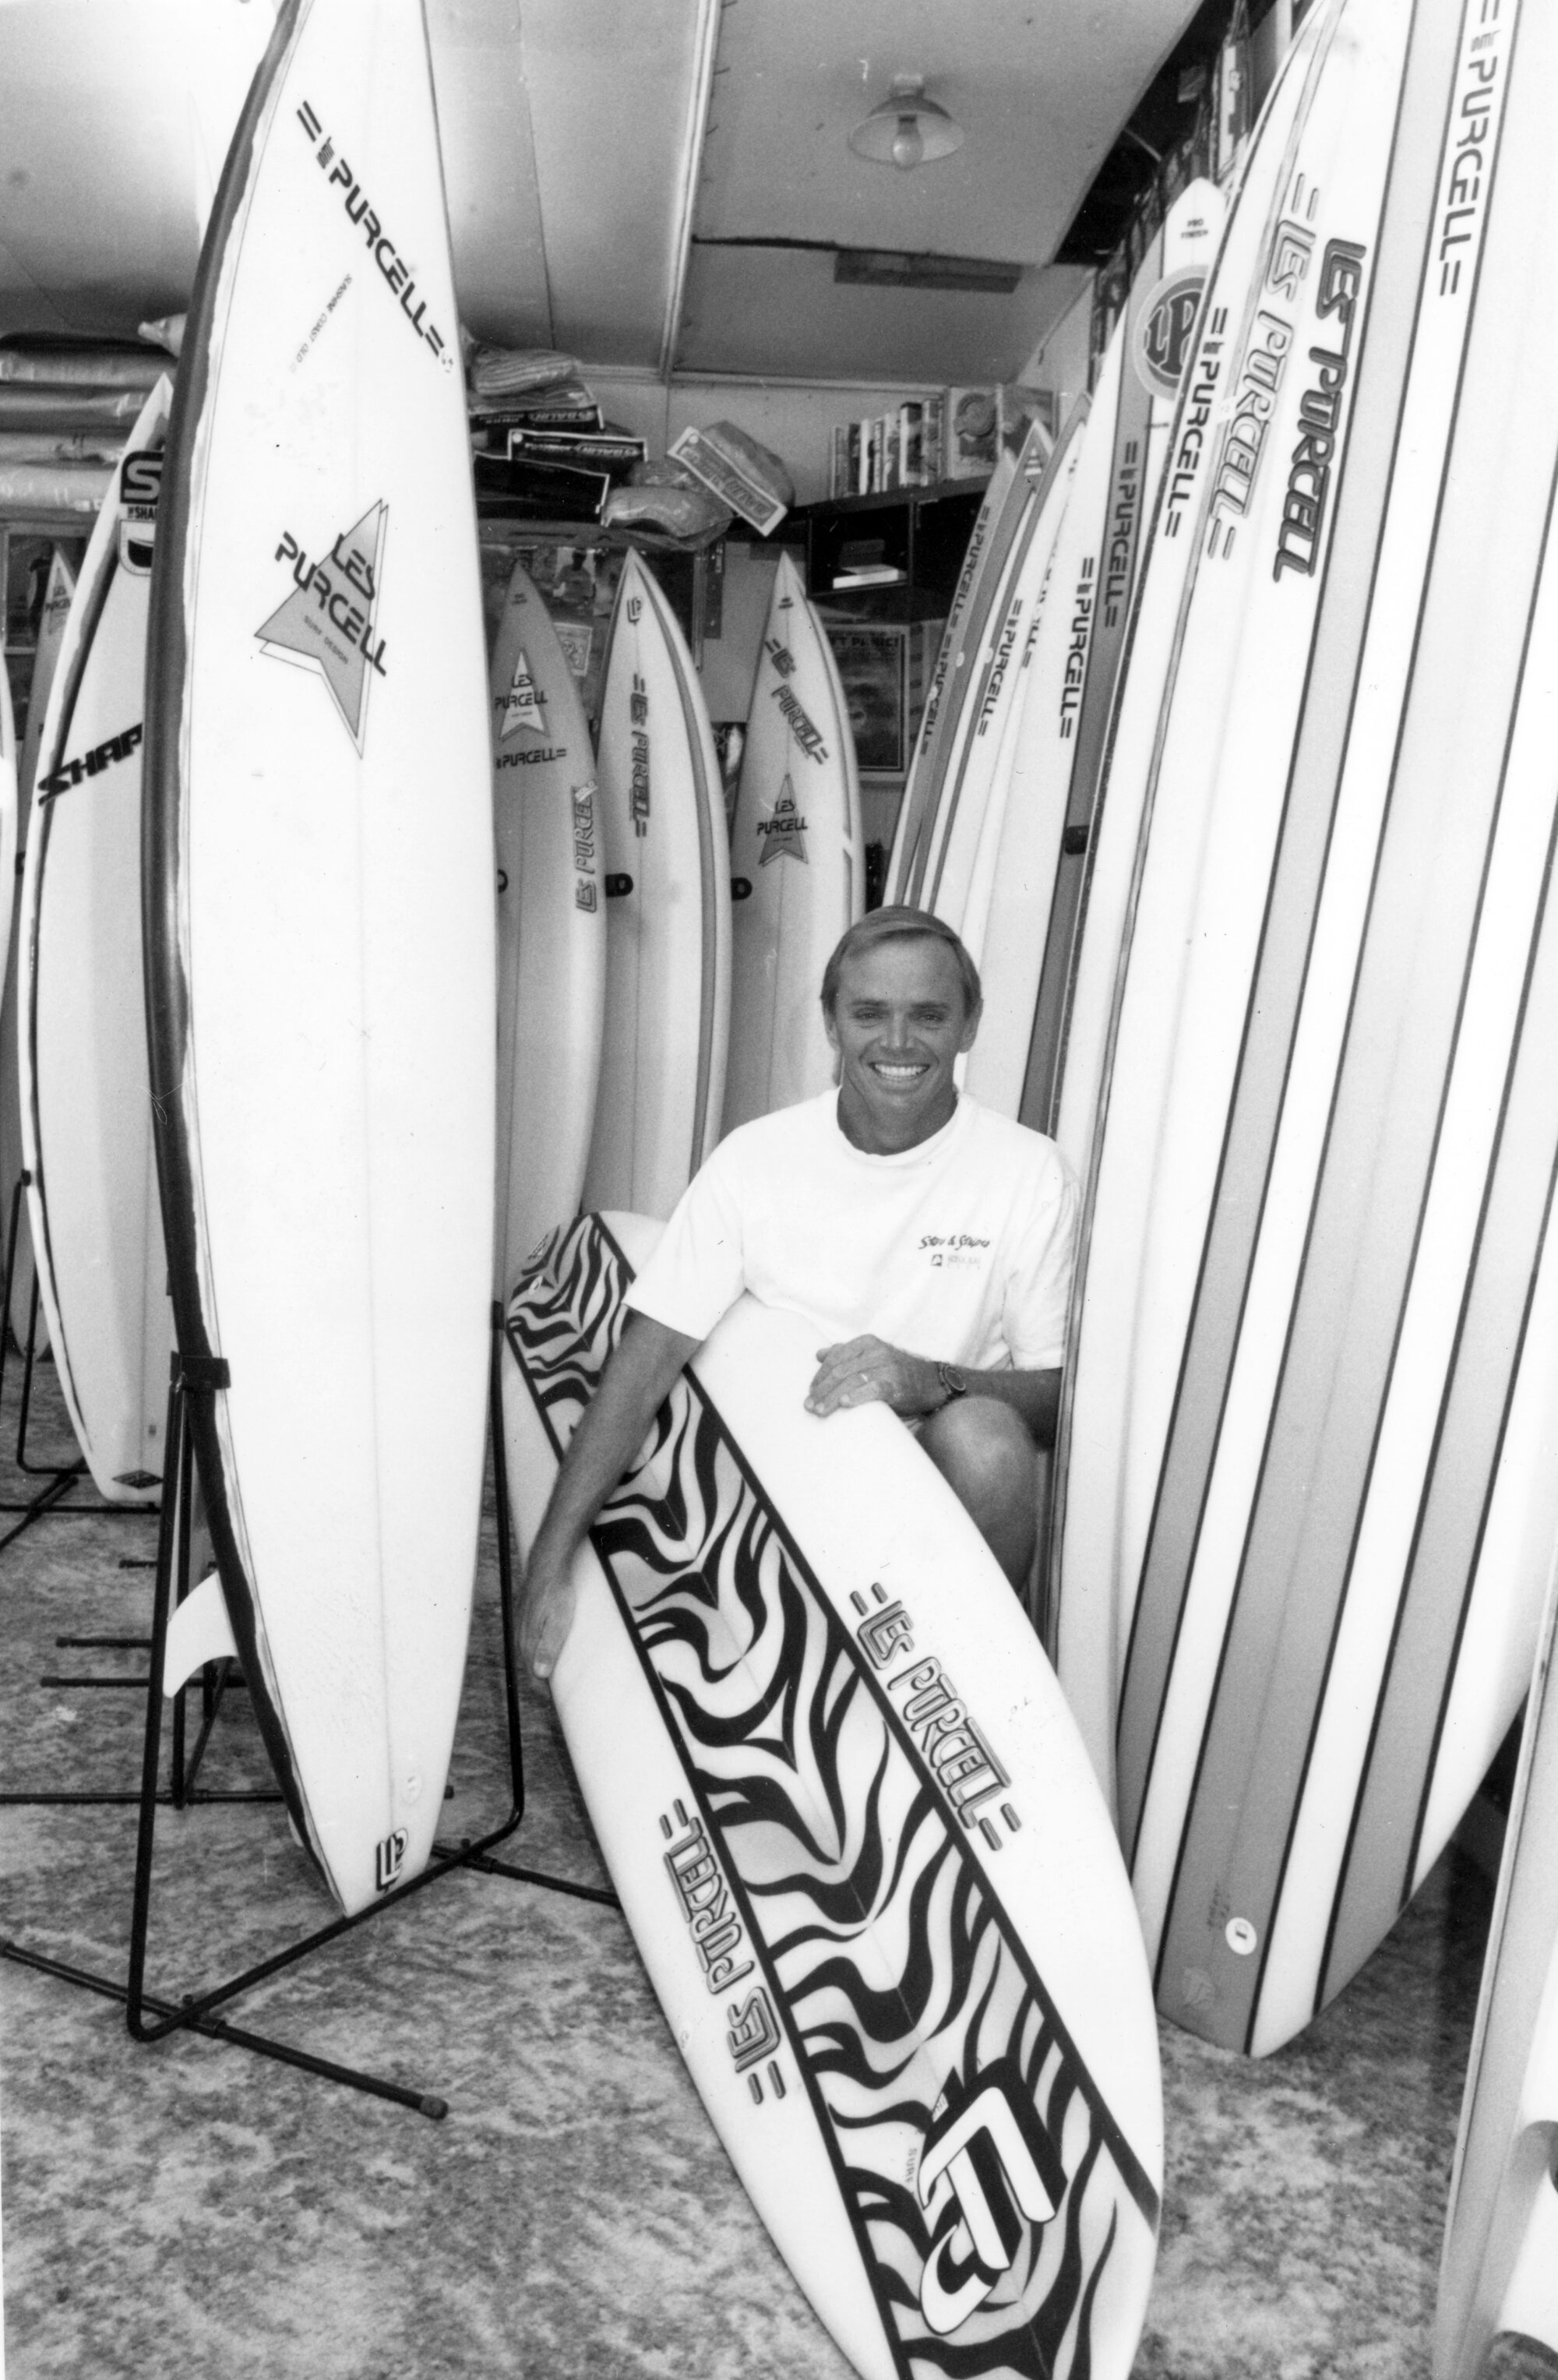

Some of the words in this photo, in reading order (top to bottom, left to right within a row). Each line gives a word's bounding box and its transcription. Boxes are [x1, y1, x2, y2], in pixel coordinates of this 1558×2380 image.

[1439, 55, 1498, 262] PURCELL
[328, 158, 428, 339] PURCELL
[1265, 219, 1317, 302] LES
[1315, 237, 1368, 325] LES
[308, 312, 328, 343] COAST
[326, 273, 354, 314] SUNSHINE
[1168, 361, 1221, 509] PURCELL
[1210, 309, 1295, 520] PURCELL
[1273, 345, 1349, 584] PURCELL
[135, 506, 157, 520] SHA
[1105, 483, 1137, 606] PURCELL
[274, 530, 387, 677] PURCELL
[331, 532, 375, 601] LES
[953, 532, 985, 612] PURCELL
[494, 690, 548, 711] PURCELL
[511, 673, 534, 689] LES
[981, 629, 1016, 718] PURCELL
[1059, 598, 1092, 718] PURCELL
[502, 748, 556, 768] PURCELL
[771, 683, 824, 756] PURCELL
[630, 730, 650, 821] PURCELL
[774, 799, 795, 814] LES
[756, 816, 809, 836] PURCELL
[575, 877, 597, 914] LES
[857, 1599, 915, 1671] LES
[886, 1655, 1013, 1830] PURCELL
[662, 1816, 756, 1995] PURCELL
[726, 1986, 782, 2074] LES
